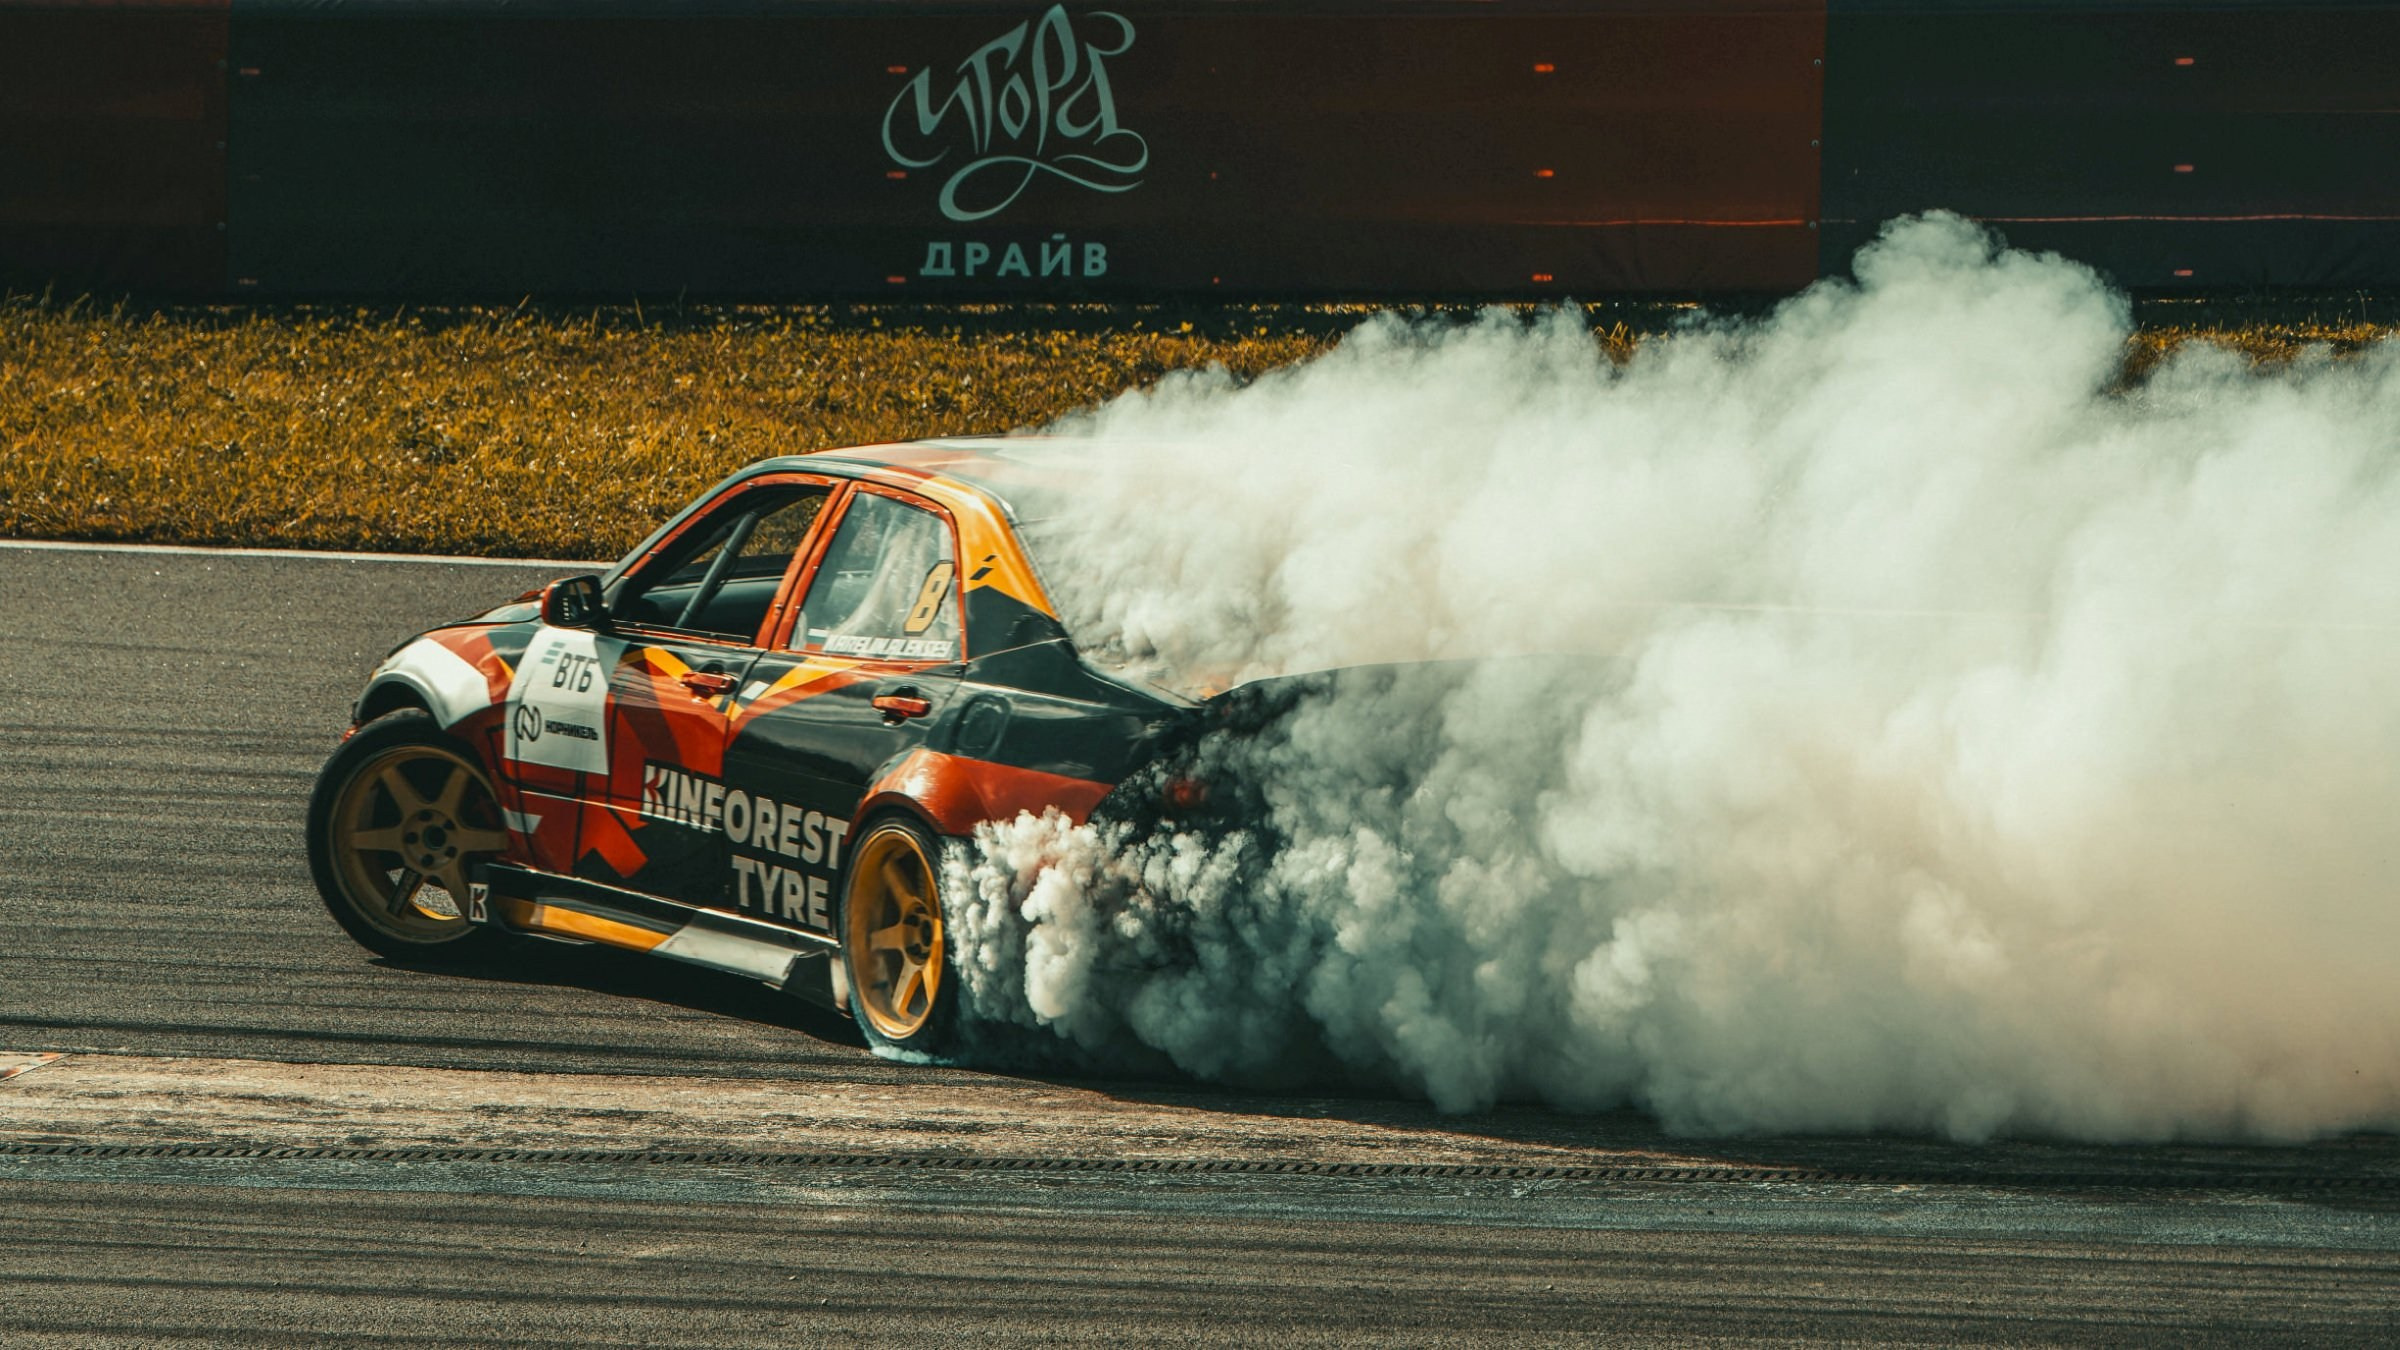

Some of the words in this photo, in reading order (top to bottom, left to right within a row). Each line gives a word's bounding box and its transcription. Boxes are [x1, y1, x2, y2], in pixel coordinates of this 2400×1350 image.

[920, 233, 1108, 277] ДРАЙВ
[904, 560, 955, 636] 8
[552, 652, 600, 693] ВТБ
[642, 764, 850, 870] KINFOREST
[731, 854, 829, 930] TYRE
